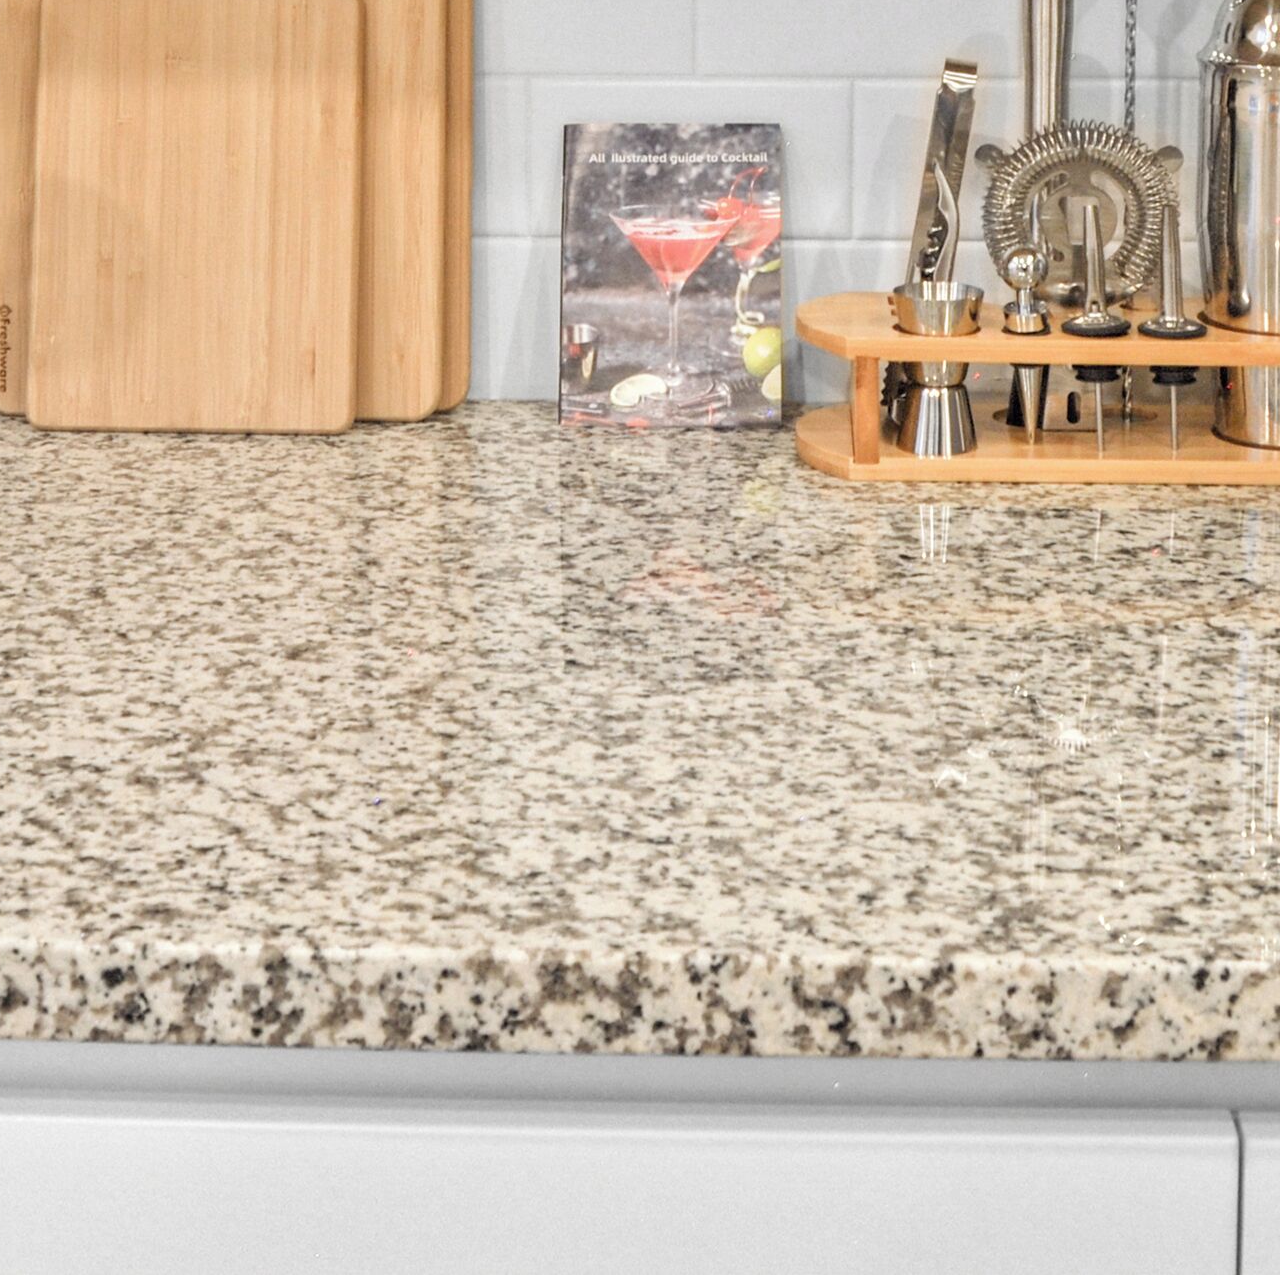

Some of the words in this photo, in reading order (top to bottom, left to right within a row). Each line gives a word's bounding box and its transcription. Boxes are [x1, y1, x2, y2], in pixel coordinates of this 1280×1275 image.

[589, 153, 605, 163] All
[670, 152, 703, 165] guide
[706, 153, 718, 163] to
[721, 152, 768, 163] Cocktail
